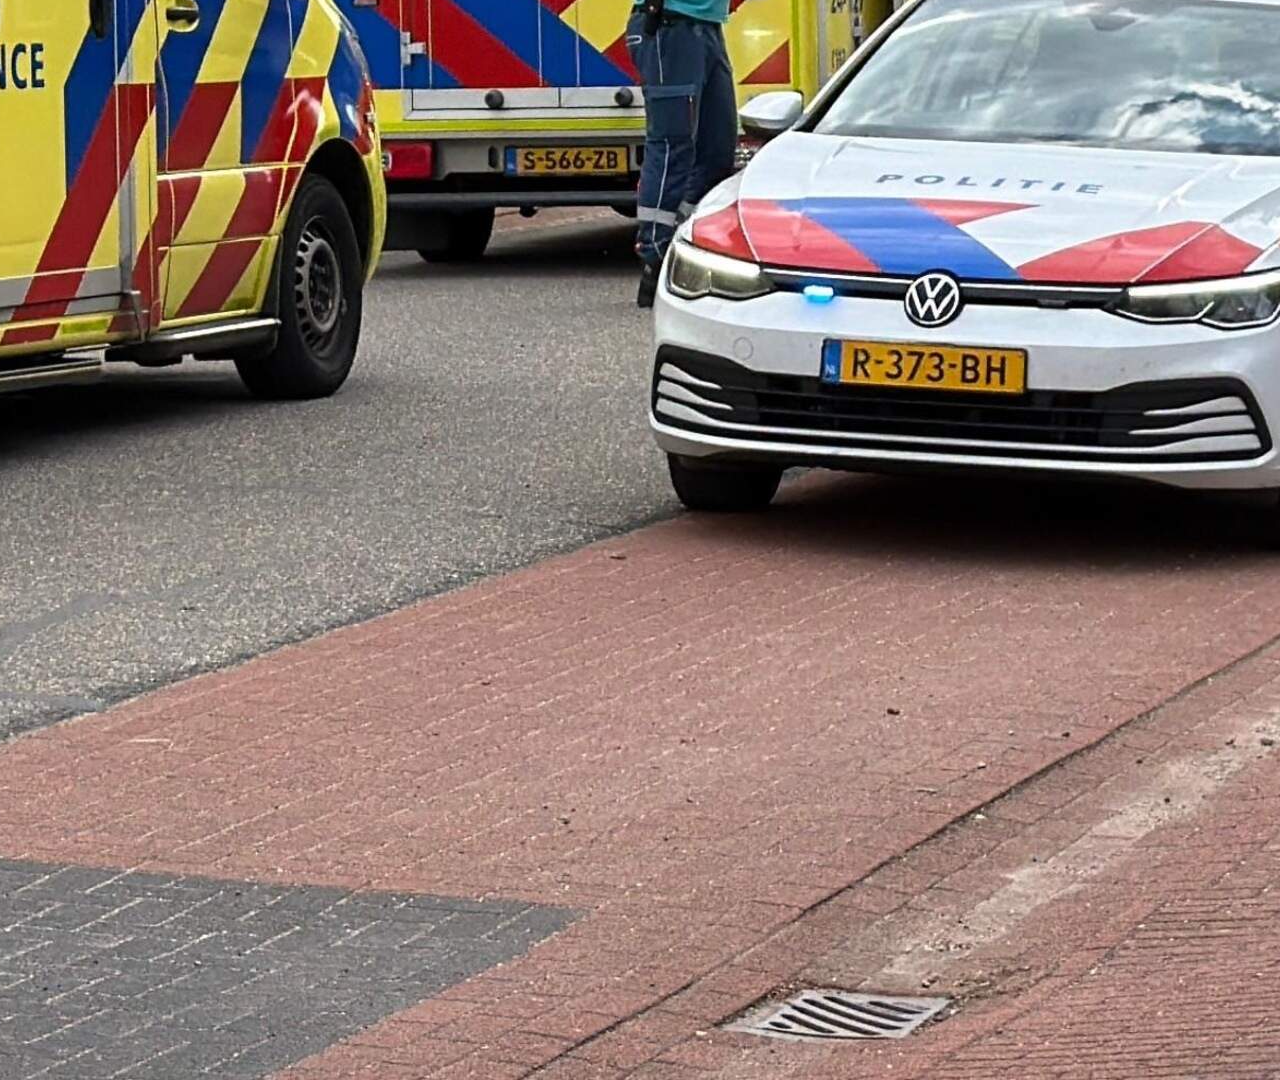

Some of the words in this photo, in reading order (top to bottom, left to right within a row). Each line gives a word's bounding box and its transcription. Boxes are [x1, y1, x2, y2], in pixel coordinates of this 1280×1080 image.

[523, 150, 618, 170] S-566-ZB
[875, 173, 1105, 195] POLITIE
[852, 347, 1007, 386] R-373-BH
